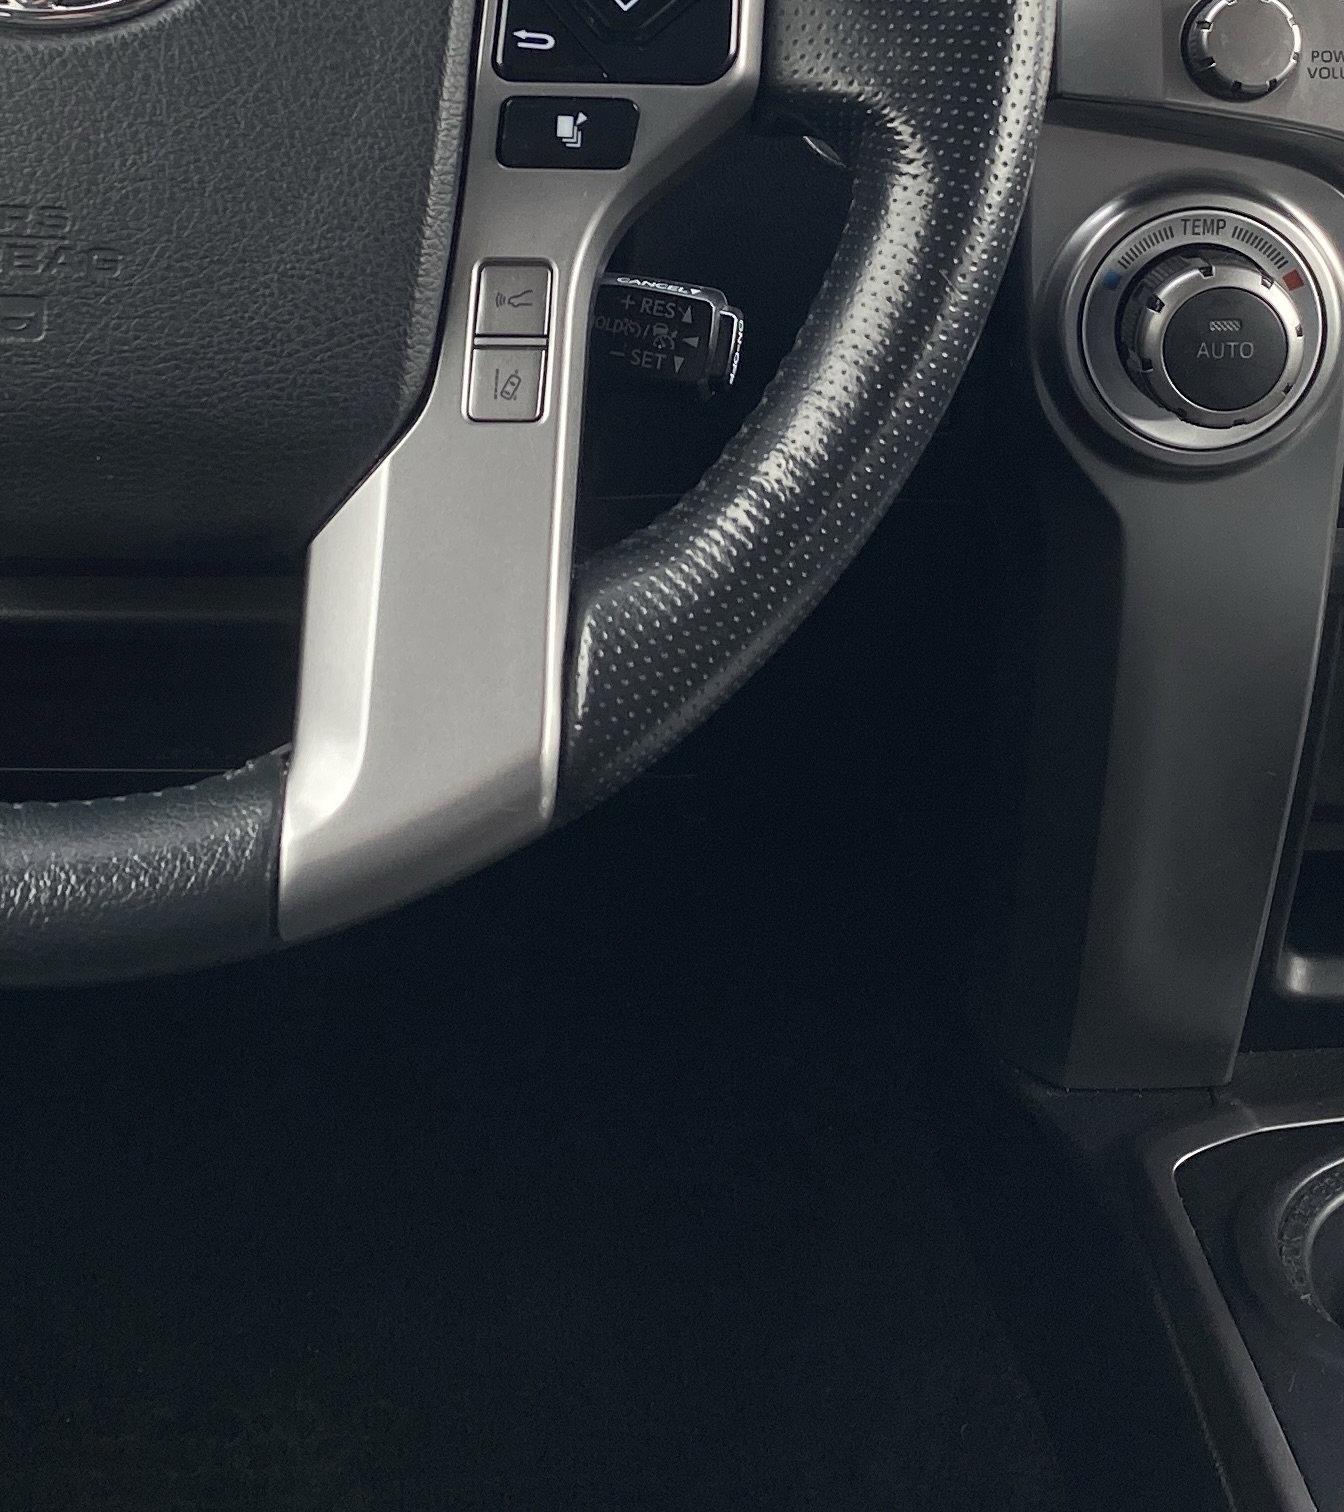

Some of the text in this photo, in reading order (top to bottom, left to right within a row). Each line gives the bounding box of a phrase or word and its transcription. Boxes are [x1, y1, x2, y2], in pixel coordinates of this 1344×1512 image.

[1180, 219, 1227, 236] TEMP
[616, 276, 689, 295] CANCEL
[639, 296, 677, 319] RES
[630, 349, 667, 370] SET
[1196, 341, 1254, 359] AUTO
